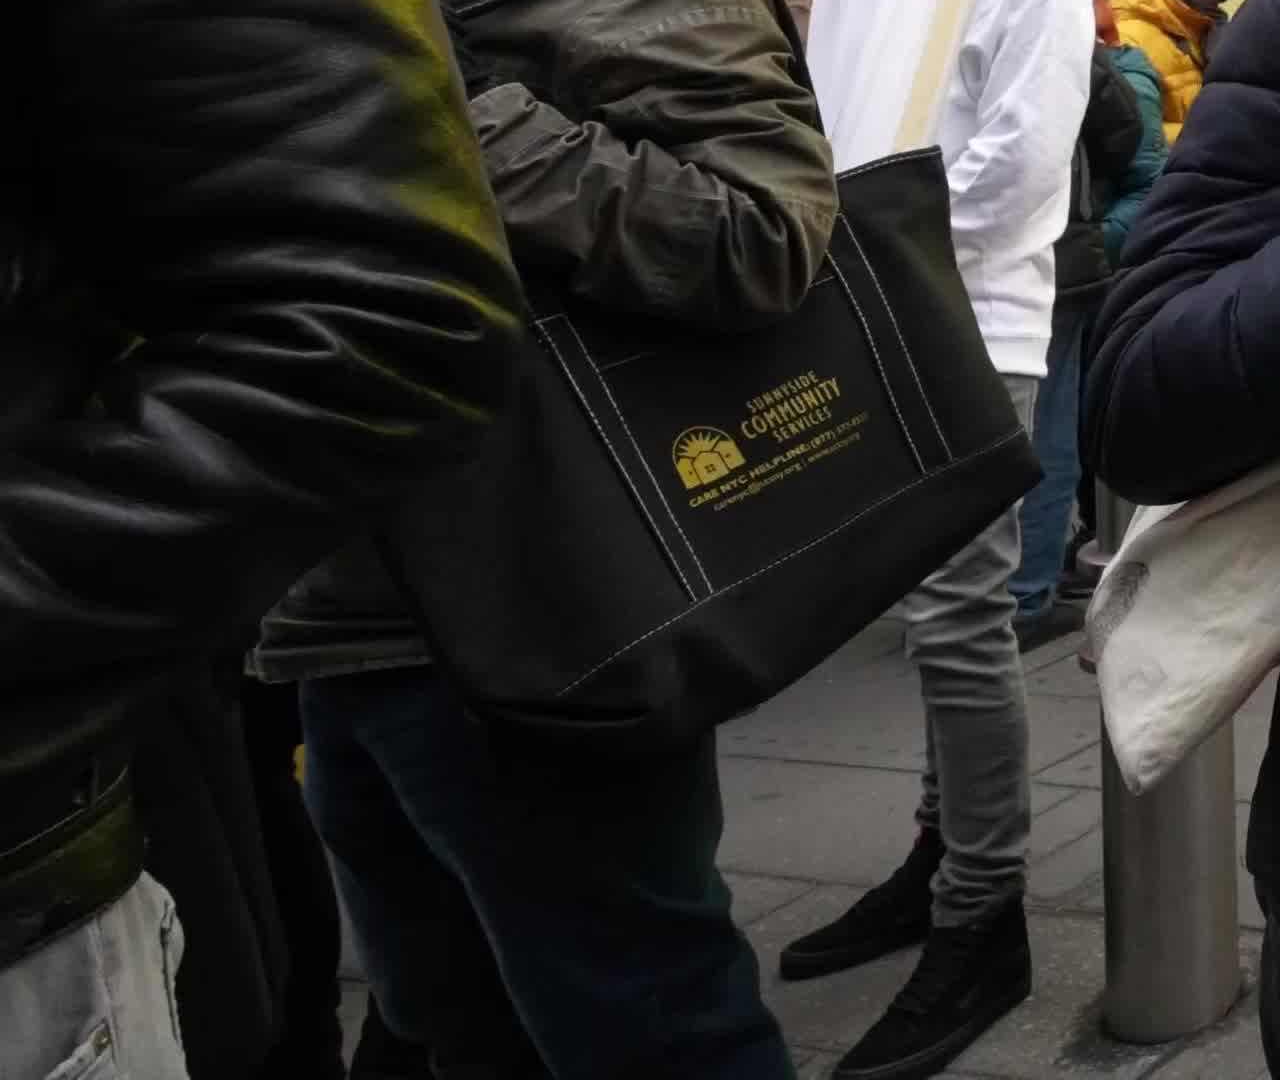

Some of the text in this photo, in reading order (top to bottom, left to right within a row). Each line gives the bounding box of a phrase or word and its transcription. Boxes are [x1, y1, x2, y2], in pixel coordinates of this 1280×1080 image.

[741, 377, 841, 440] COMMUNITY
[745, 370, 819, 413] SUNNYSIDE
[772, 406, 833, 443] SERVICES
